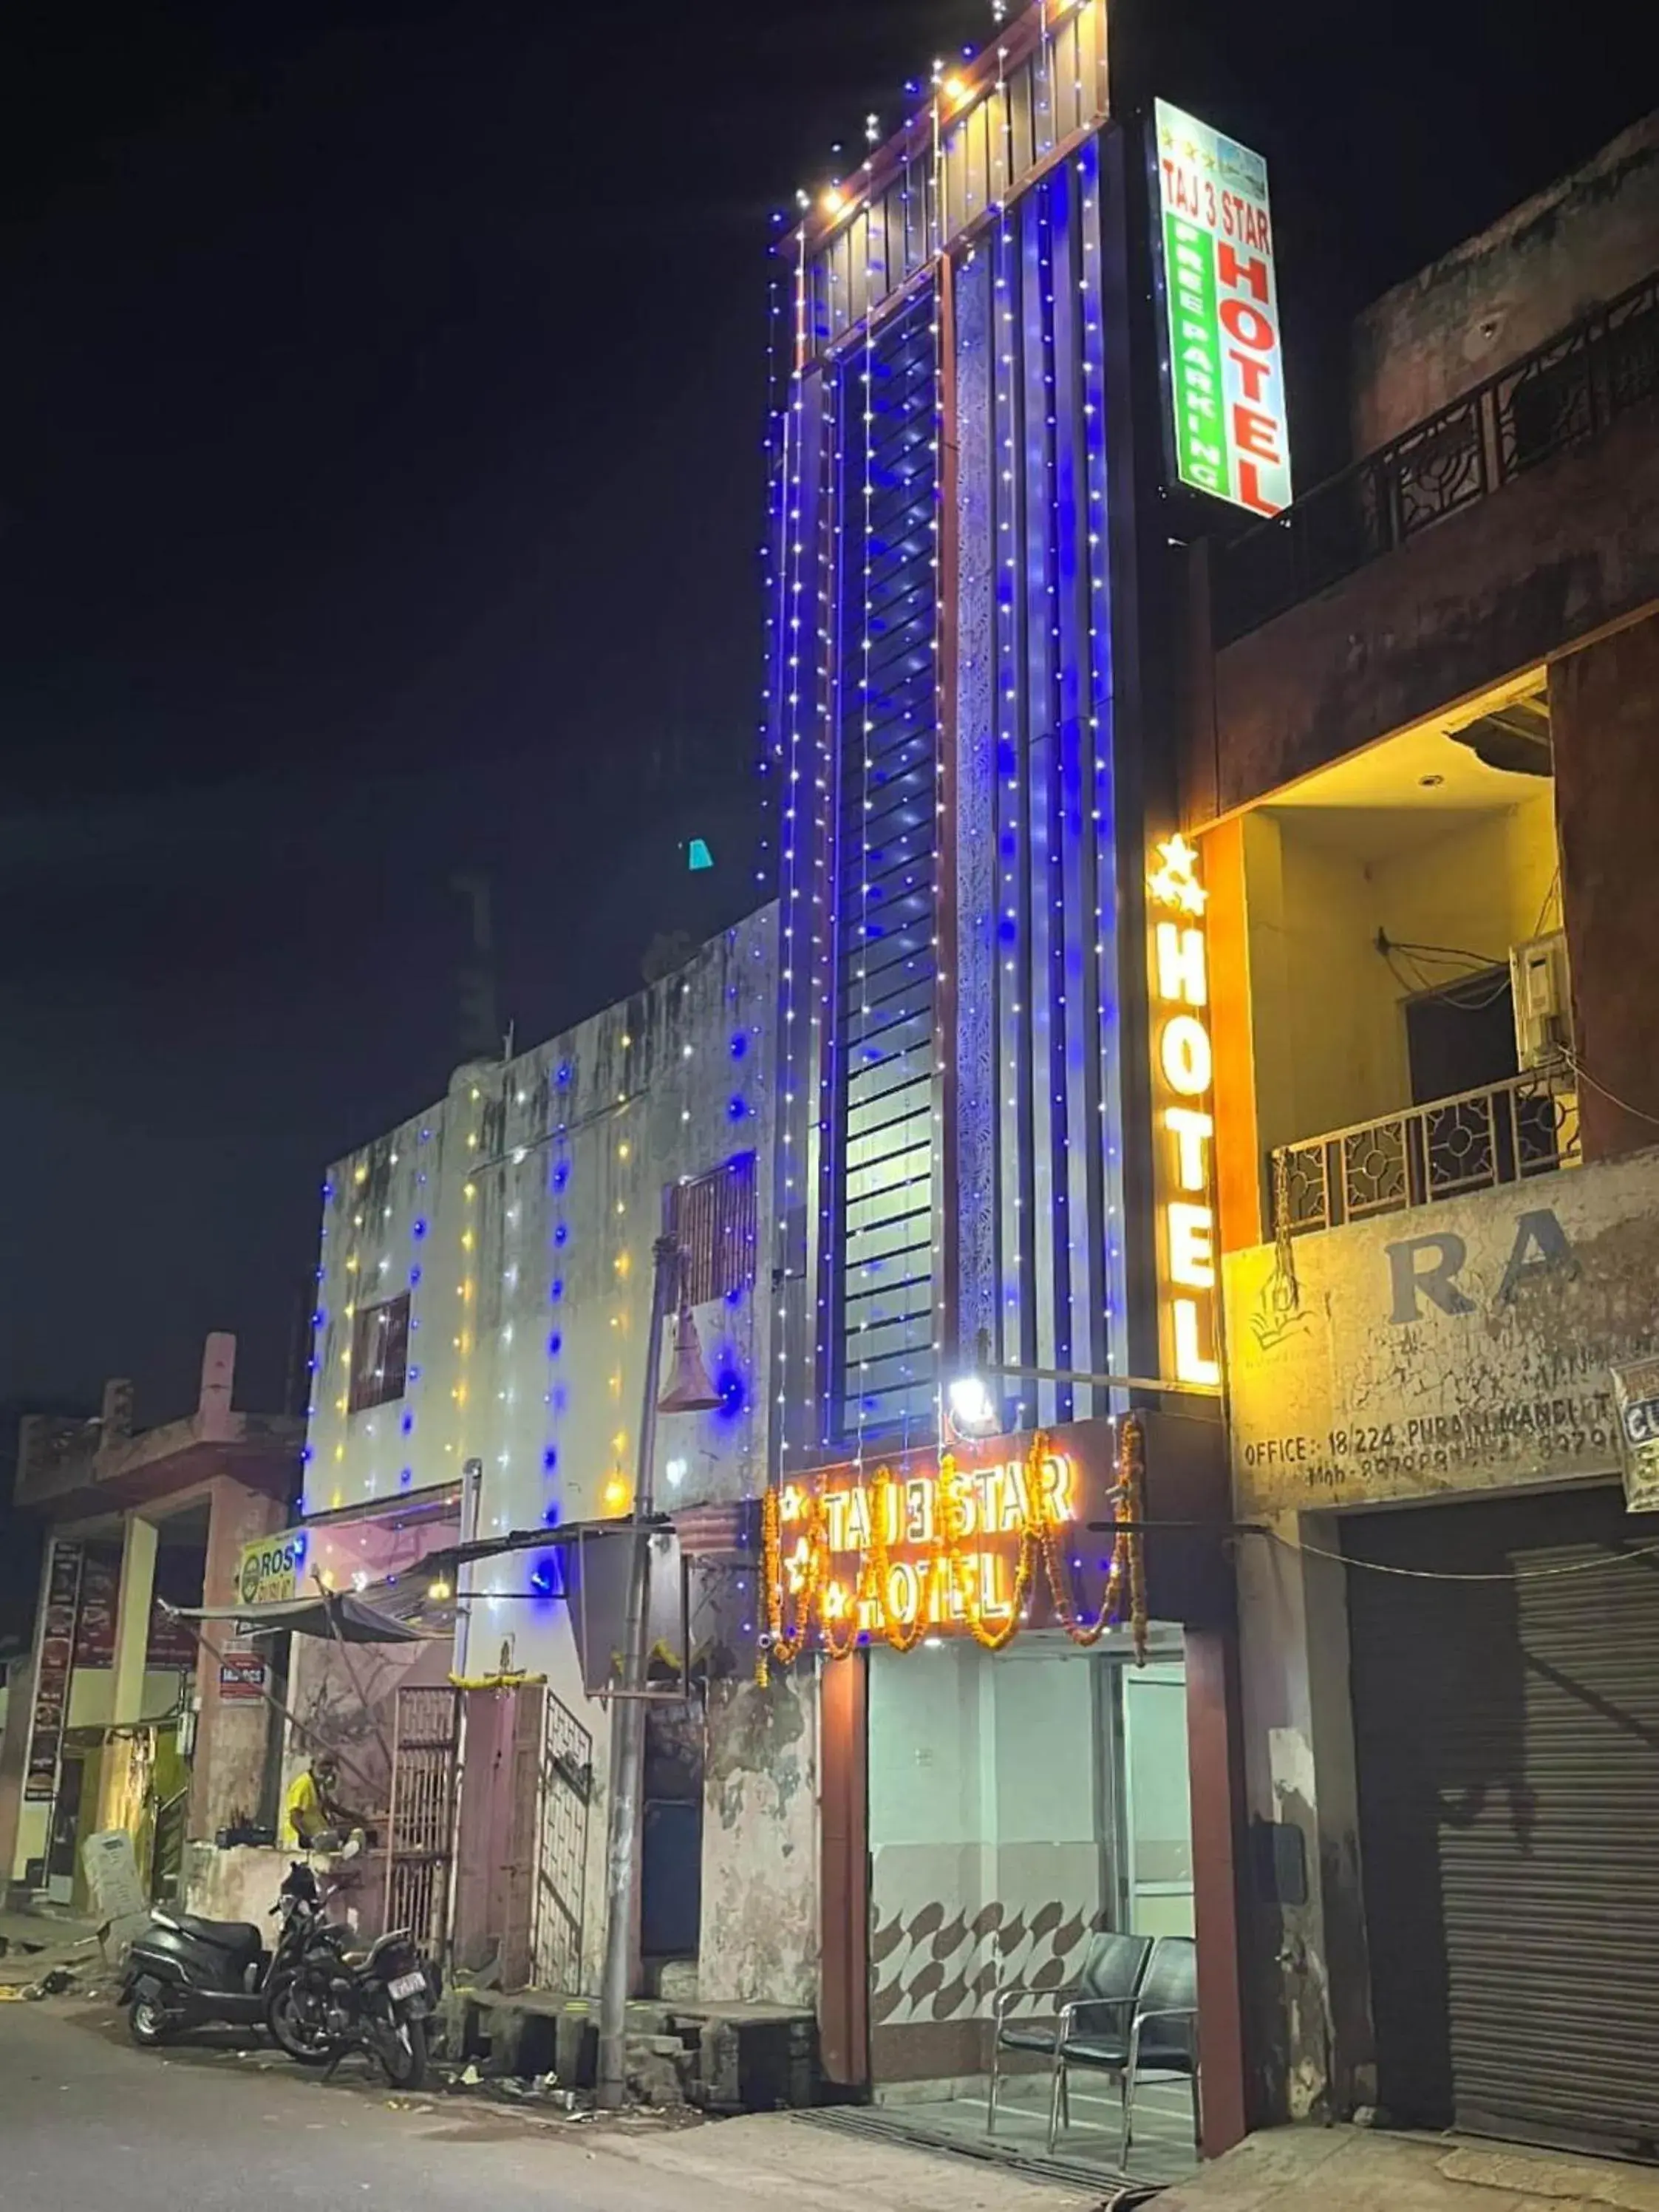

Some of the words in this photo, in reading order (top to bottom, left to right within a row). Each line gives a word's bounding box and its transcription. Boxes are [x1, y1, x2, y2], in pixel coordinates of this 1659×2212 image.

[1162, 157, 1199, 218] TAJ
[1205, 180, 1216, 228] 3
[1221, 189, 1271, 256] STAR
[1173, 220, 1205, 316] FREE
[1182, 319, 1221, 489] PARKING
[1217, 240, 1284, 518] HOTEL
[1156, 921, 1220, 1386] HOTEL
[822, 1481, 903, 1553] TAJ
[907, 1476, 935, 1545] 3
[946, 1452, 1079, 1538] STAR
